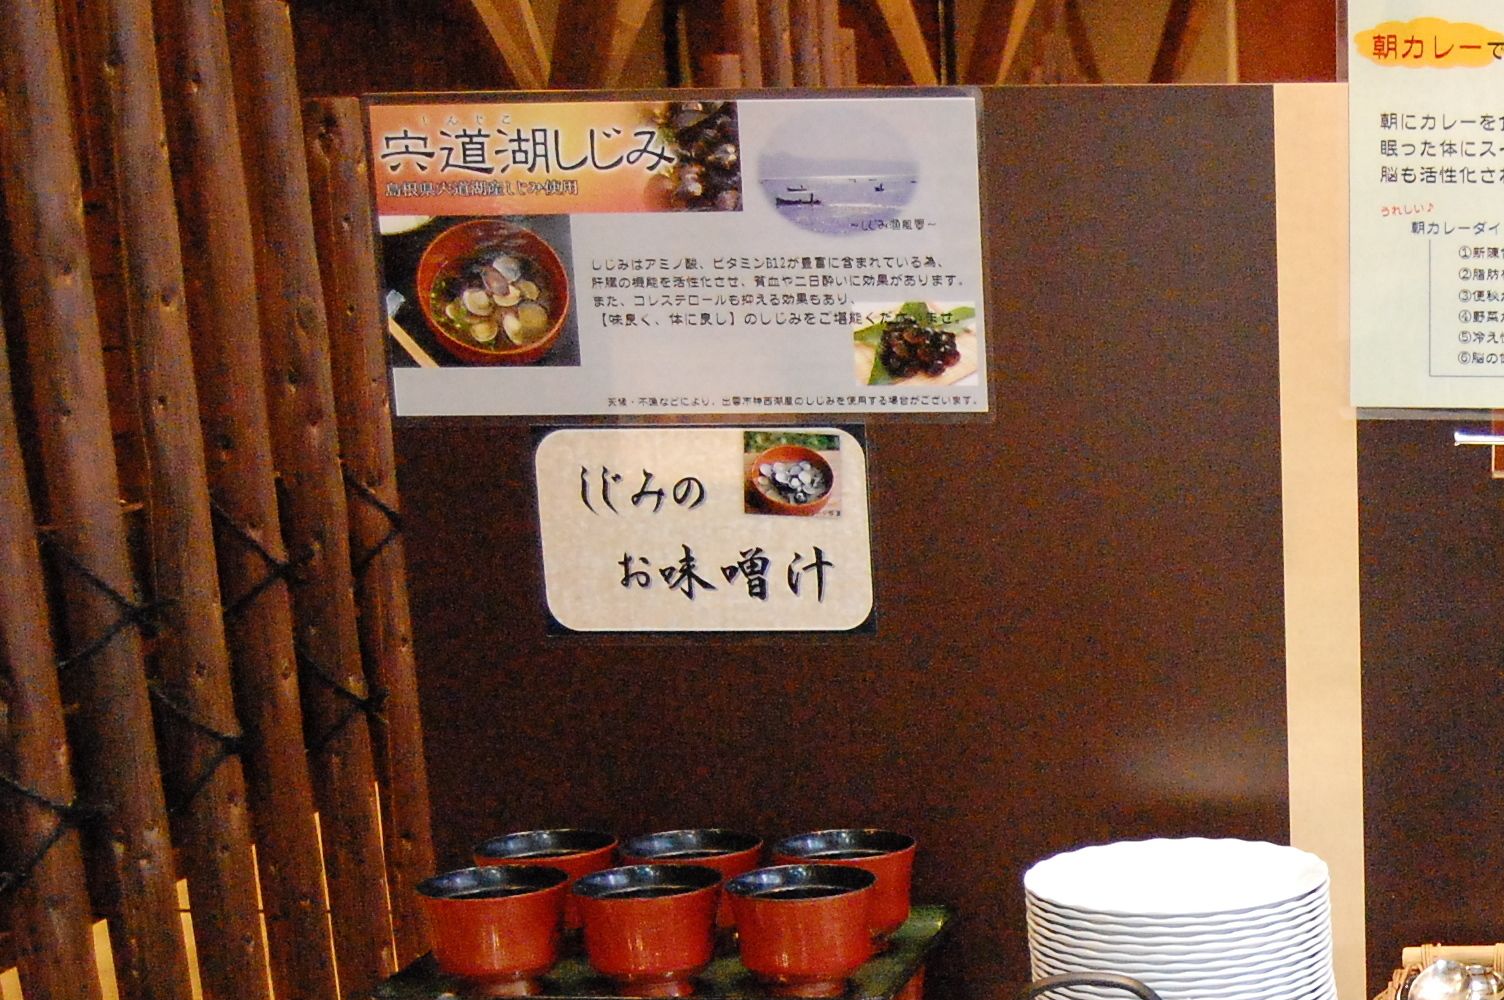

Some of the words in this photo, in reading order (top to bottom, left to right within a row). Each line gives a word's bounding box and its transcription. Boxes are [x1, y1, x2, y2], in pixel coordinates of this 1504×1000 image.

[380, 127, 676, 175] 宍道湖しじみ
[581, 466, 705, 515] しじみの
[617, 544, 835, 602] お味噌汁
